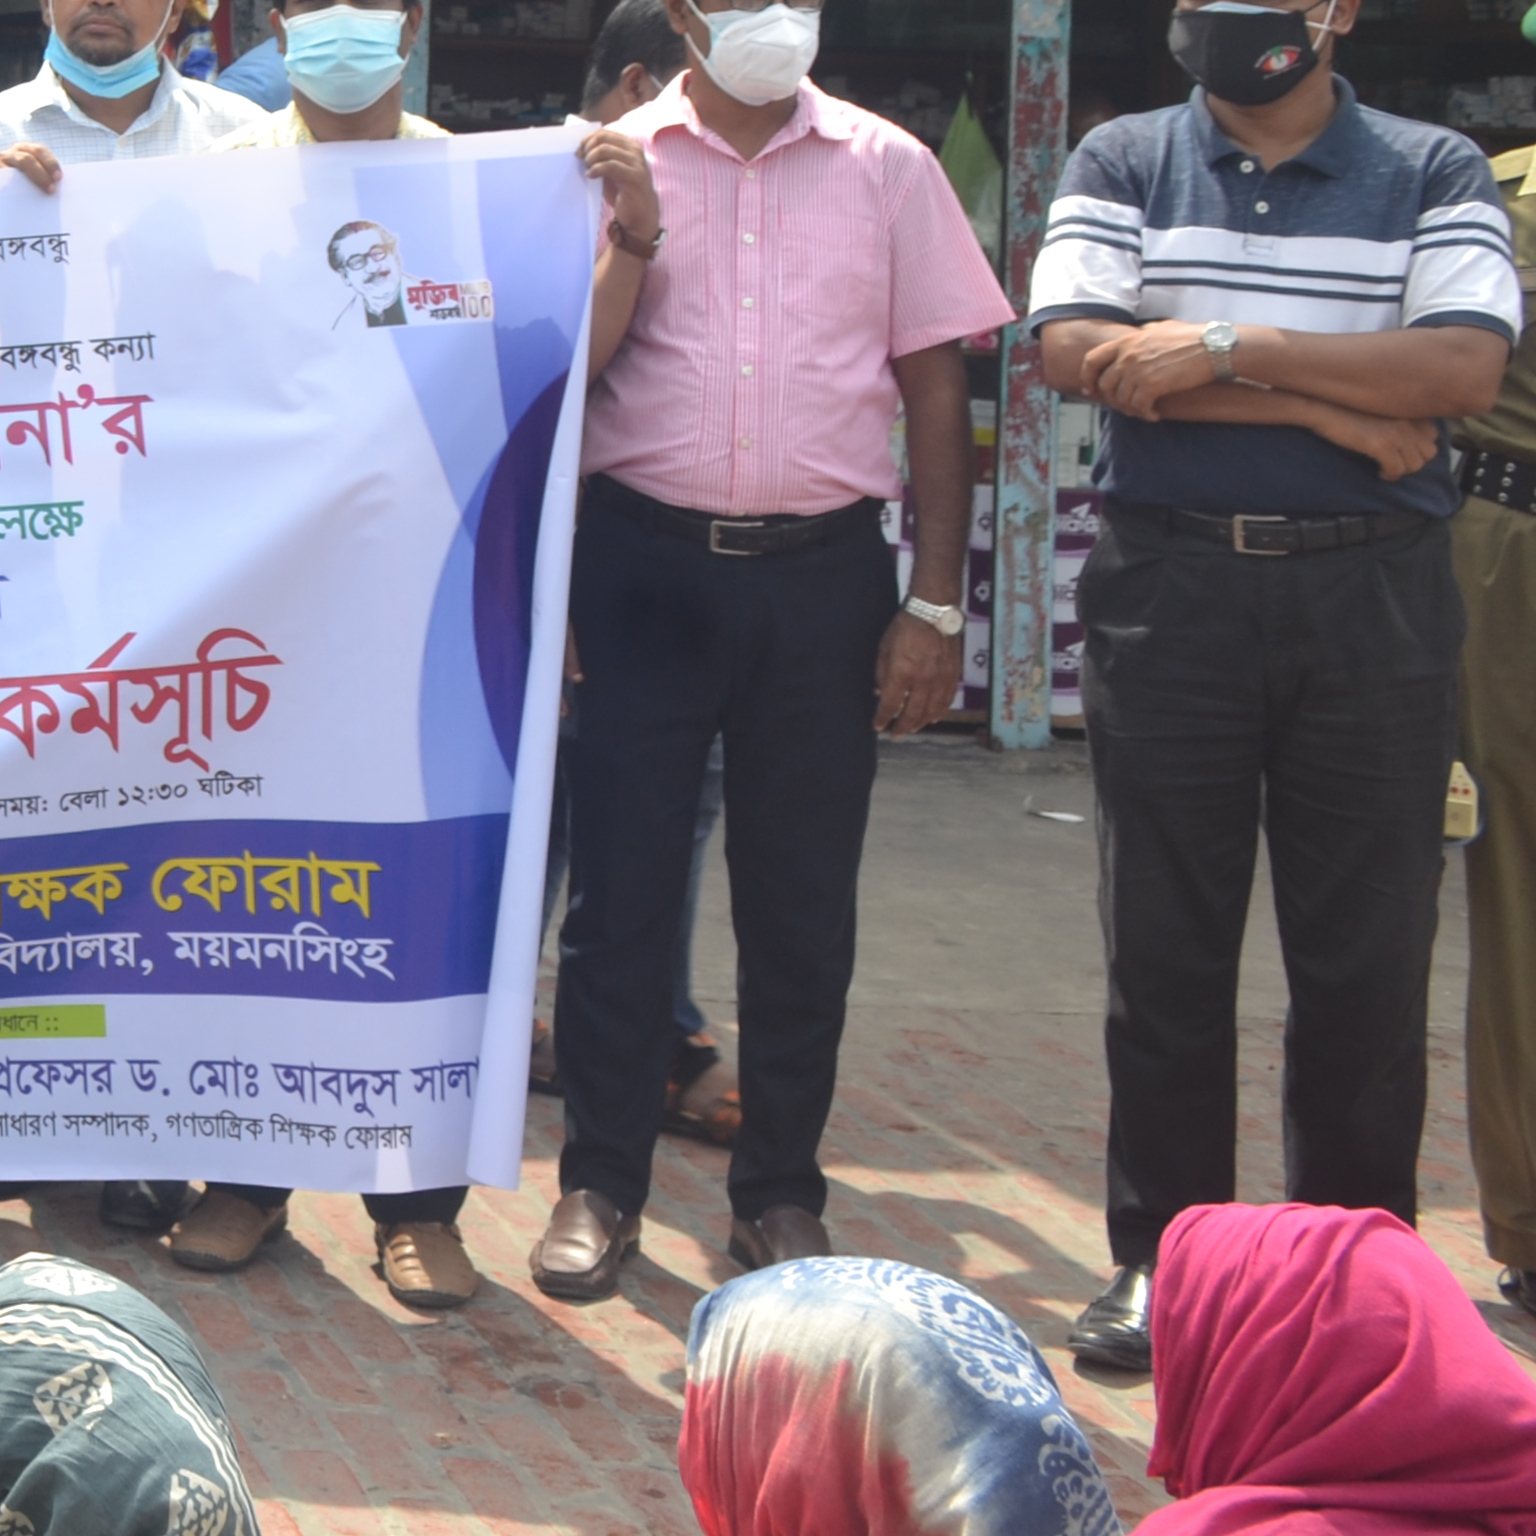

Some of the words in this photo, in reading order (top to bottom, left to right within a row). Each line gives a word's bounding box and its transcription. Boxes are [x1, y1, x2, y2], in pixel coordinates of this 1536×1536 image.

[90, 331, 156, 363] কন্যা
[59, 787, 107, 814] বেলা
[197, 772, 263, 800] ঘটিকা
[151, 848, 382, 920] ফোরাম
[167, 921, 397, 980] ময়মনসিংহ
[125, 1059, 171, 1099] ড.
[188, 1057, 259, 1101] মোঃ
[270, 1060, 401, 1116] আবদুস
[64, 1113, 158, 1143] সম্পাদক,
[166, 1109, 264, 1142] গণতান্ত্রিক
[269, 1113, 337, 1146] শিক্ষক
[343, 1120, 414, 1152] ফোরাম
